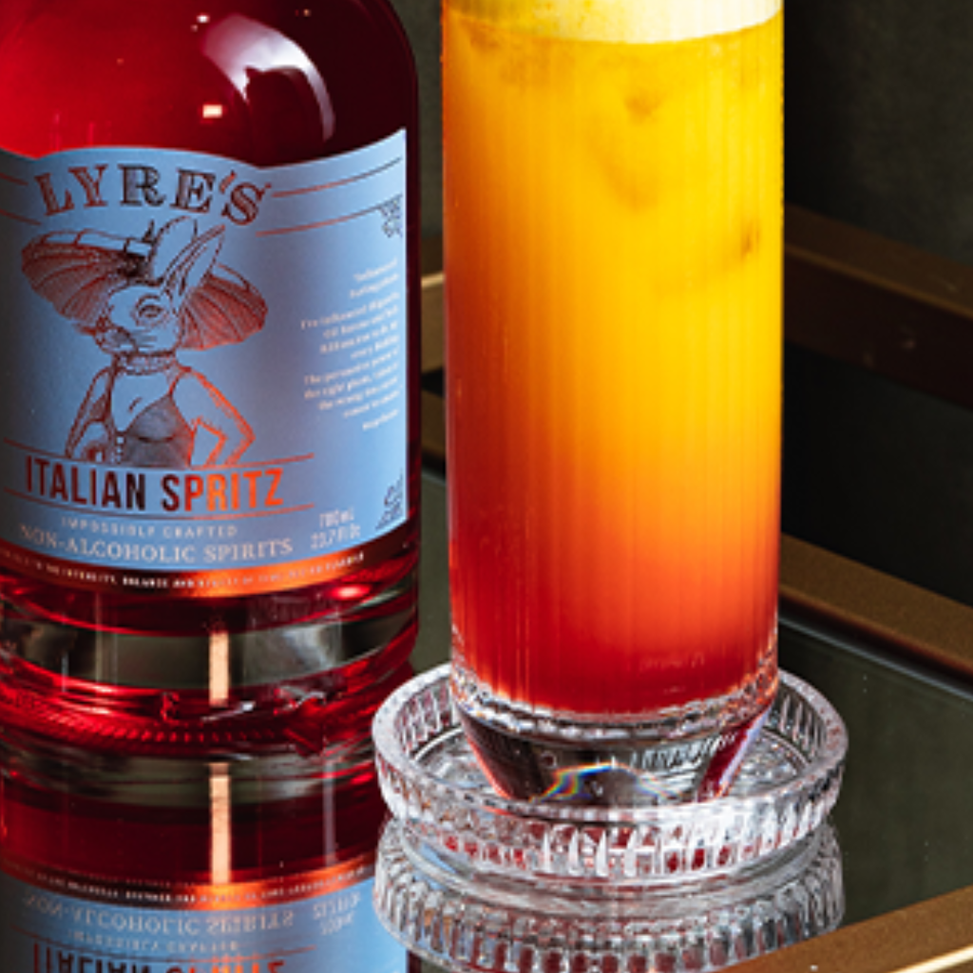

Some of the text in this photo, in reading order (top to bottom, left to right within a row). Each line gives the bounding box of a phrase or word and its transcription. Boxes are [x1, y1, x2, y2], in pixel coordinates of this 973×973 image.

[35, 163, 272, 225] LYRE'S
[25, 456, 284, 512] ITALIAN SPRITZ
[19, 523, 196, 564] NON-ALCOHOLIC
[203, 537, 294, 563] SPIRITS
[163, 525, 238, 540] CRAFTED
